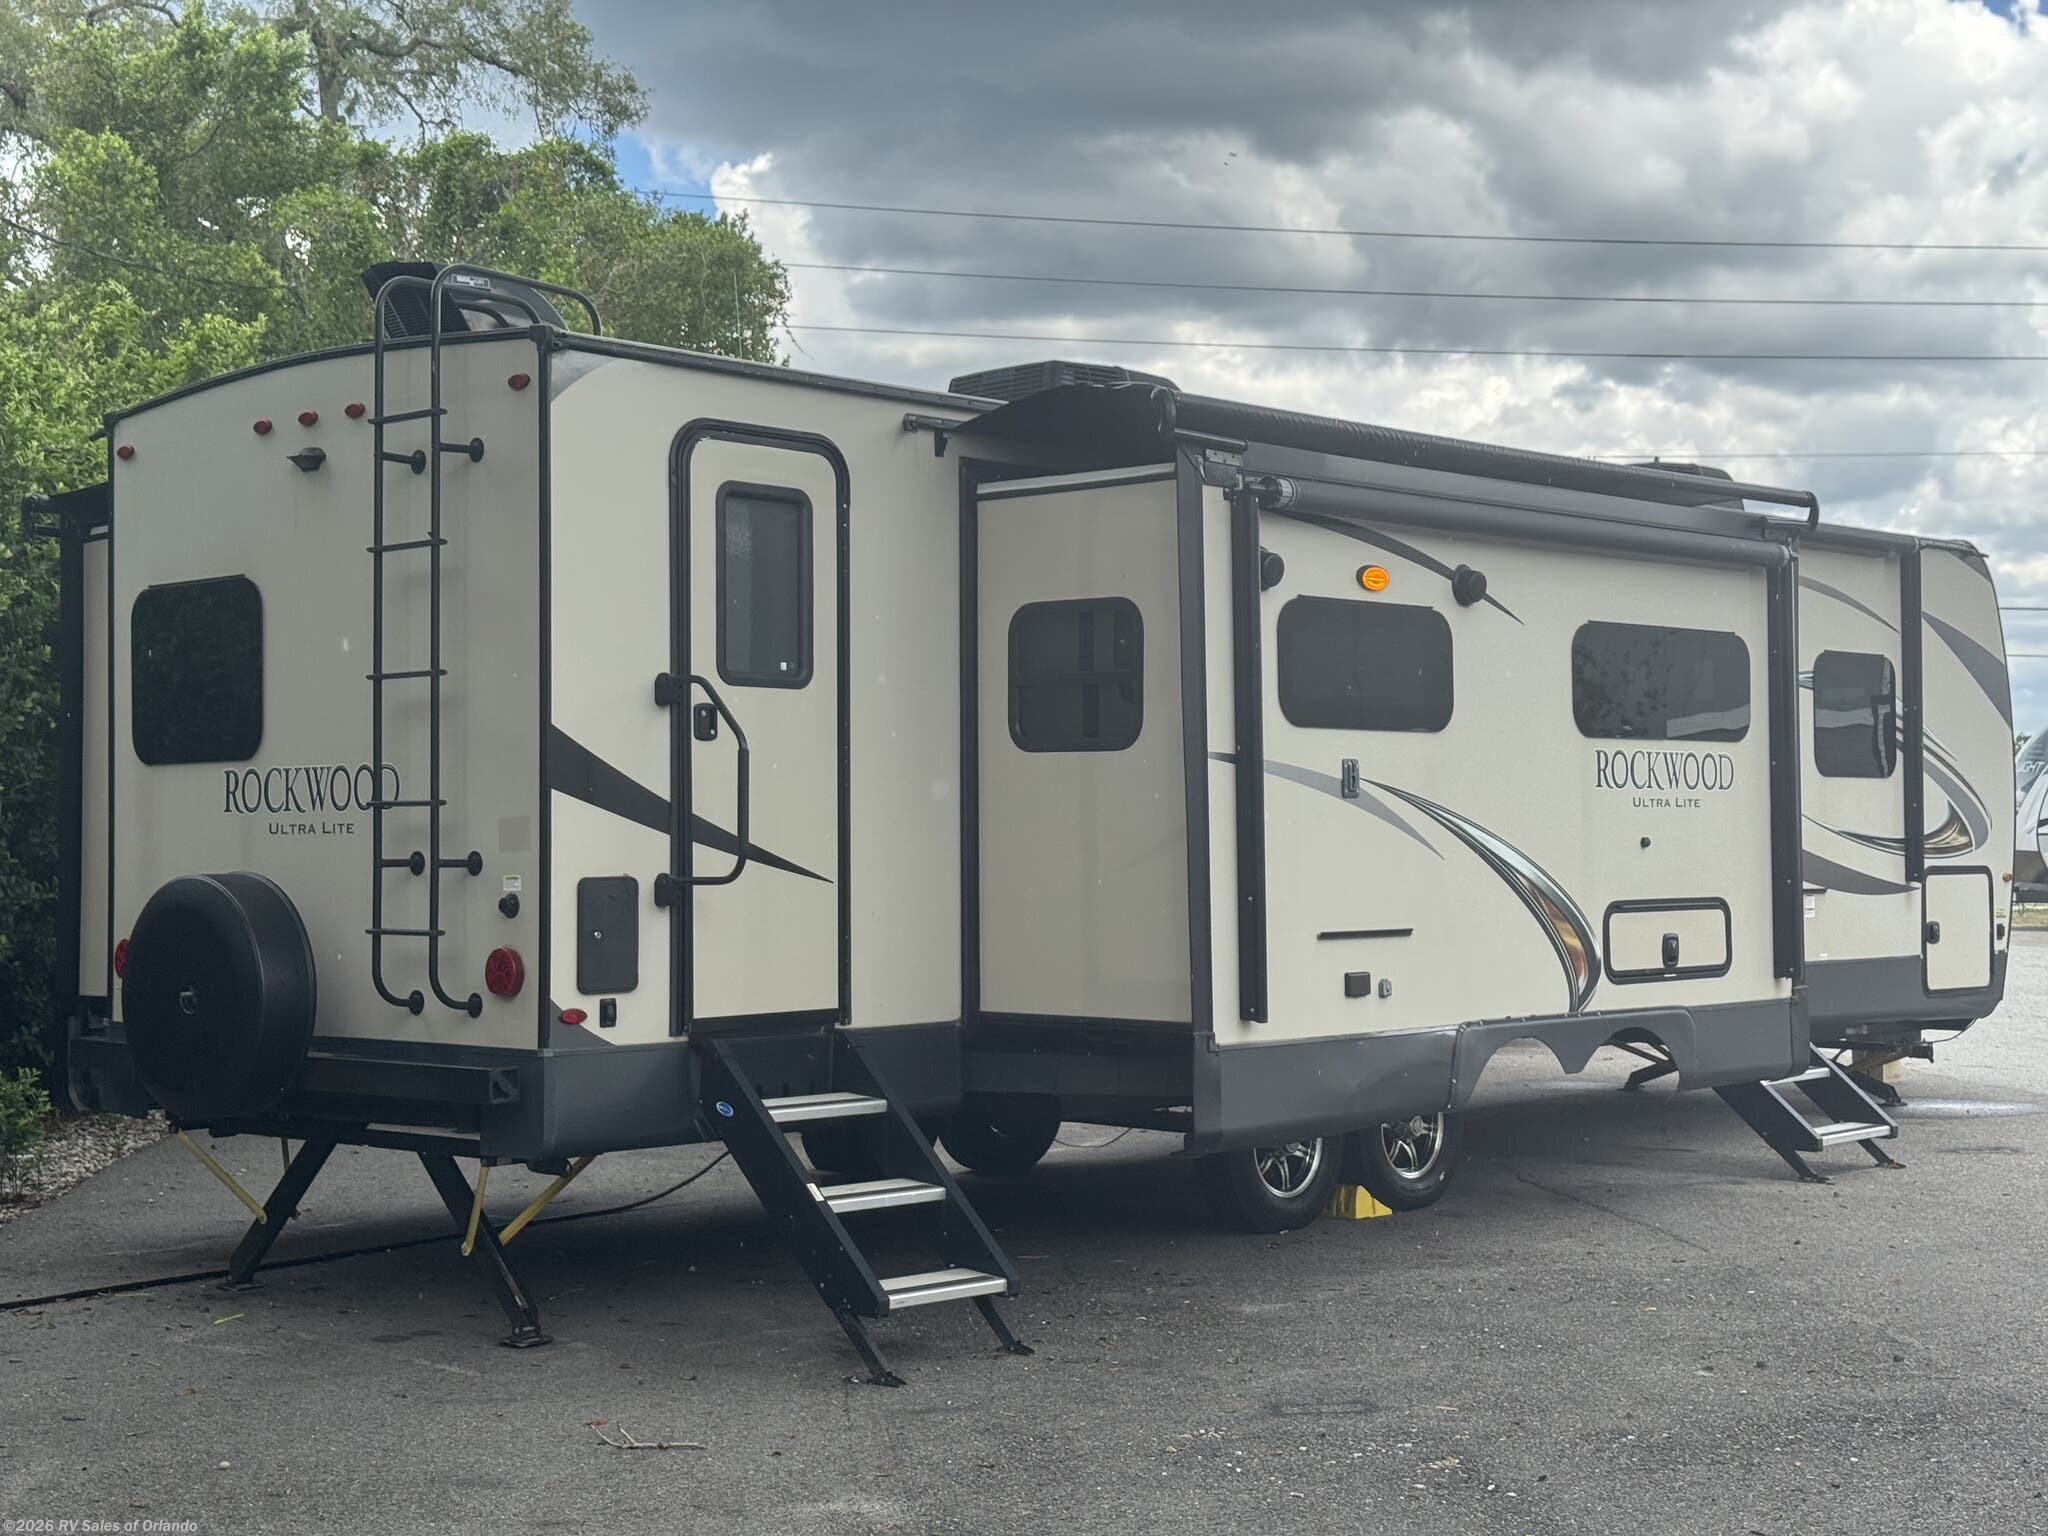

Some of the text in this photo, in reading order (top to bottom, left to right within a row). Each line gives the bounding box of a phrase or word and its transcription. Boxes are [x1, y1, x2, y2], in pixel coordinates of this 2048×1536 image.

[1594, 749, 1734, 791] ROCKWOOD
[223, 763, 400, 814] ROCKWOOD
[1632, 796, 1701, 808] ULTRA LITE
[268, 821, 355, 835] ULTRA LITE
